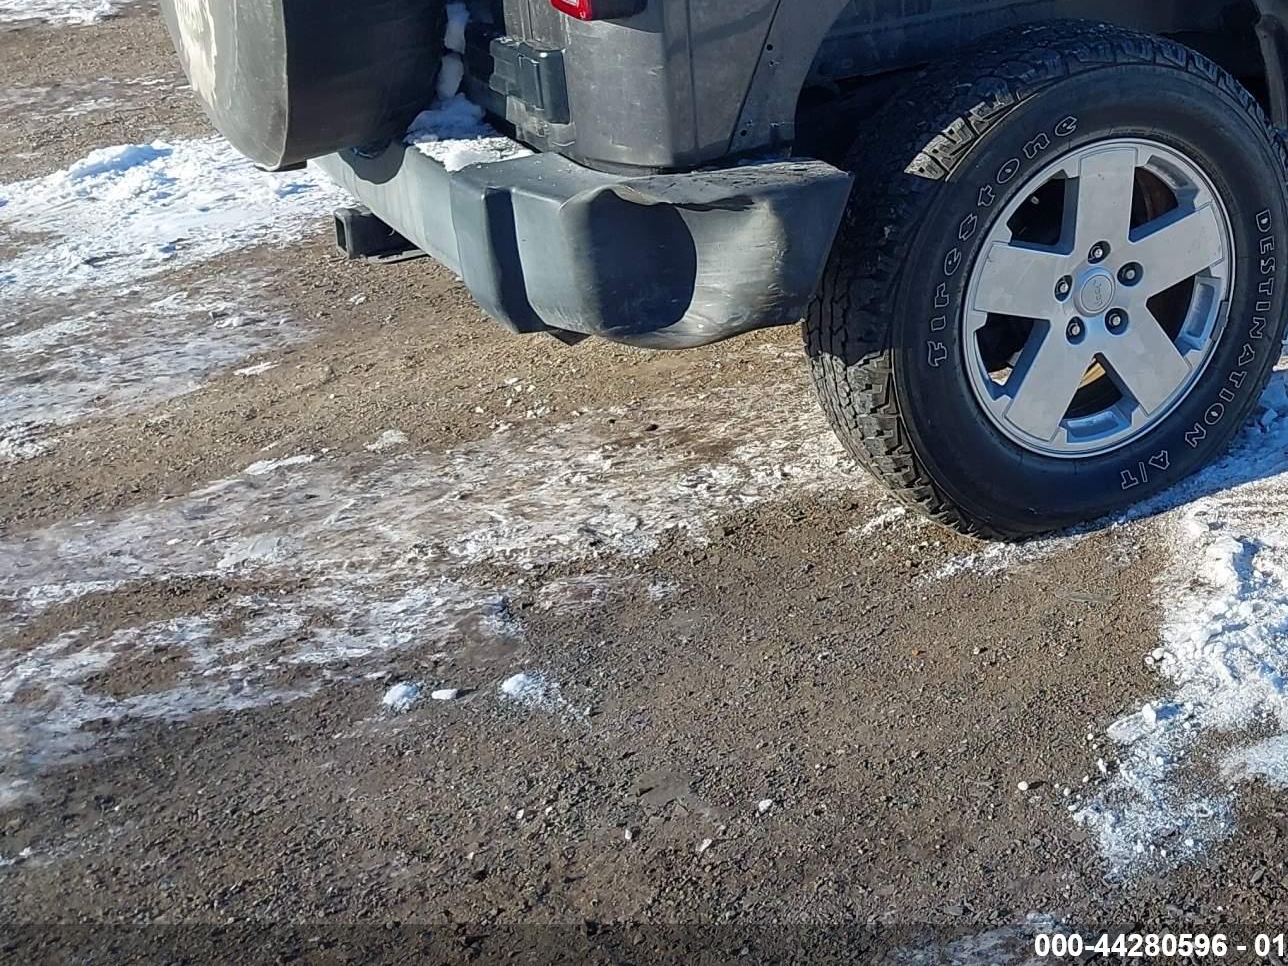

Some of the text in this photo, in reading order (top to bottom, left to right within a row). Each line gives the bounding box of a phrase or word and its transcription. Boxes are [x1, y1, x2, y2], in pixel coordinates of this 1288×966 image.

[928, 115, 1078, 367] Firestone
[1120, 209, 1276, 490] DESTINATION A/T
